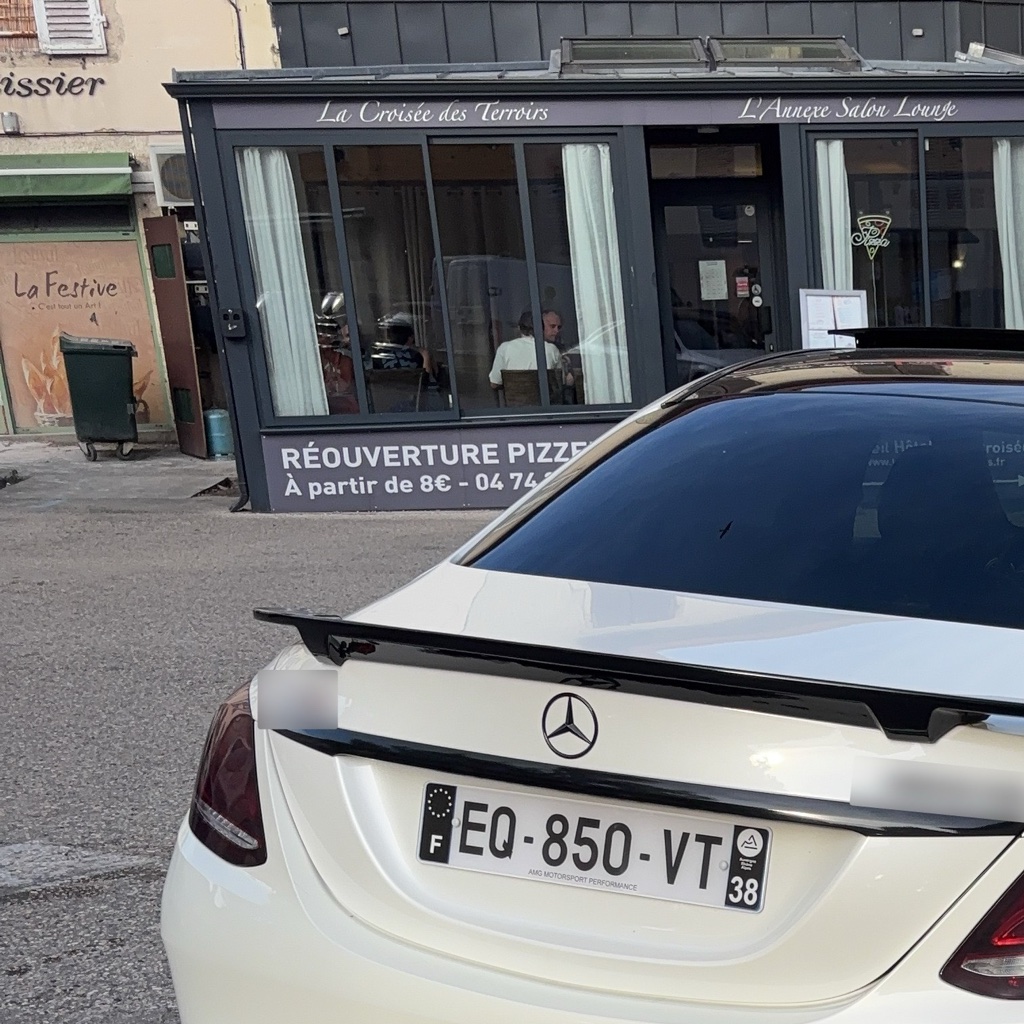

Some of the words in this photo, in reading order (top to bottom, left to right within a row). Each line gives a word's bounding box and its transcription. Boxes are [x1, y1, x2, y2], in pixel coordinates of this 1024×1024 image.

[0, 72, 105, 97] issier
[316, 100, 352, 122] La
[360, 101, 434, 122] Croisée
[439, 99, 467, 122] des
[475, 100, 548, 121] Terroirs
[738, 96, 831, 123] L'Annexe
[836, 96, 890, 118] Salon
[894, 95, 958, 121] Lounge
[15, 272, 38, 299] La
[45, 270, 118, 298] Festive
[38, 302, 56, 310] C'est
[58, 301, 72, 310] tout
[85, 301, 96, 309] Art
[281, 441, 500, 470] RÉOUVERTURE
[507, 441, 593, 465] PIZZE
[988, 457, 1006, 467] s.fr
[284, 473, 303, 497] À
[308, 476, 378, 500] partir
[384, 475, 414, 494] de
[420, 474, 452, 493] 8€
[475, 473, 504, 491] 04
[510, 472, 539, 490] 74
[429, 834, 443, 854] F
[459, 801, 723, 890] EQ-850-VT
[528, 868, 542, 877] AMG
[543, 870, 588, 884] MOTORSPORT
[588, 877, 638, 892] PERFORMANCE
[728, 875, 759, 906] 38
